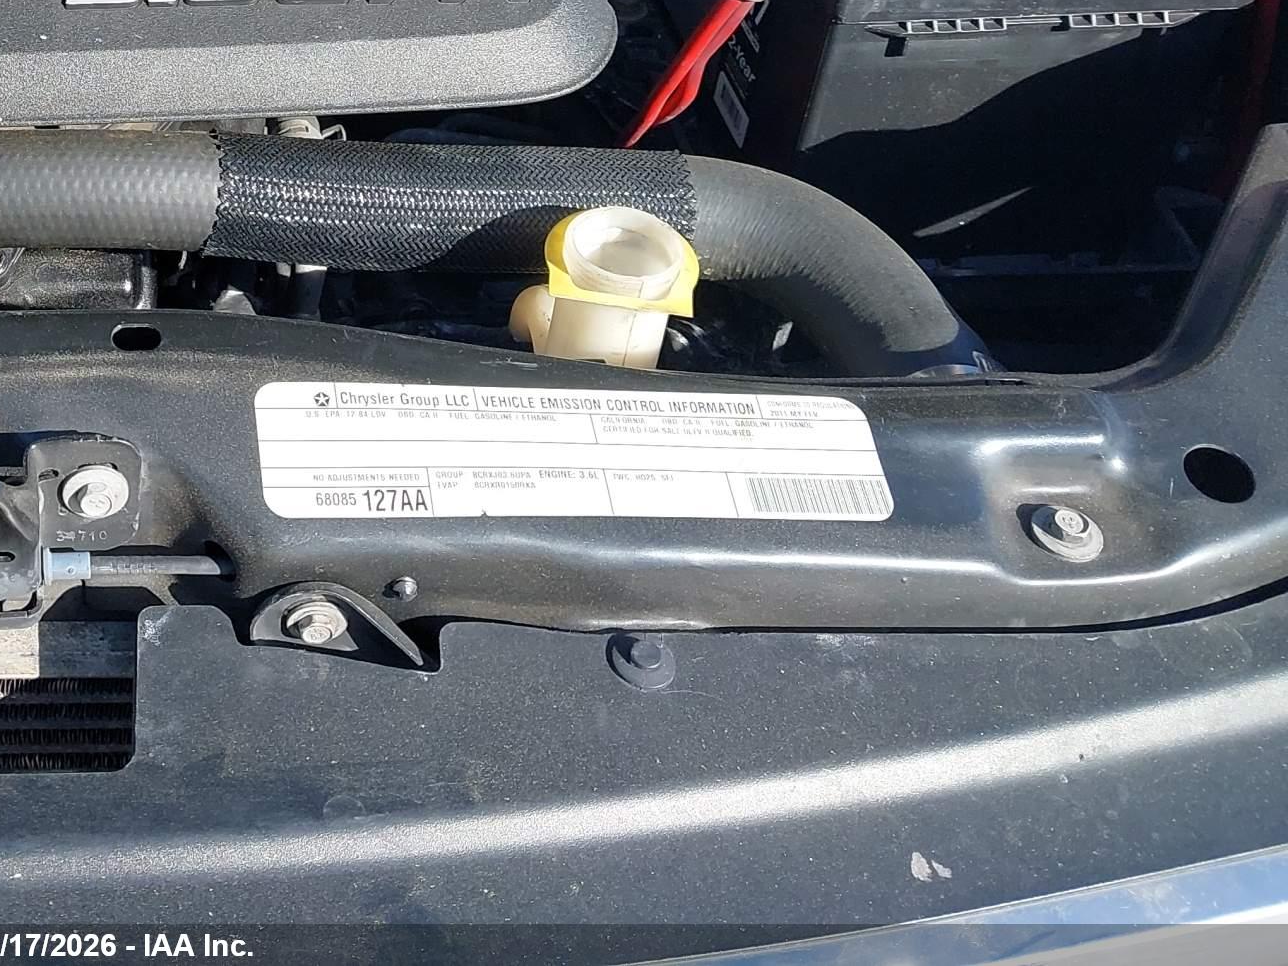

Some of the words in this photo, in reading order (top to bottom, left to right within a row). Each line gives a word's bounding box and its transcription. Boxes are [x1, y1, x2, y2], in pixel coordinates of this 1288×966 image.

[340, 392, 395, 408] Chrysler
[400, 393, 439, 408] Group
[446, 394, 469, 407] LLC
[481, 395, 535, 408] VEHICLE
[540, 398, 601, 410] EMISSION
[607, 400, 664, 412] CONTROL
[669, 401, 755, 414] INFORMATION
[579, 471, 599, 480] 3.6L
[315, 492, 357, 506] 68085
[363, 489, 428, 512] 127AA
